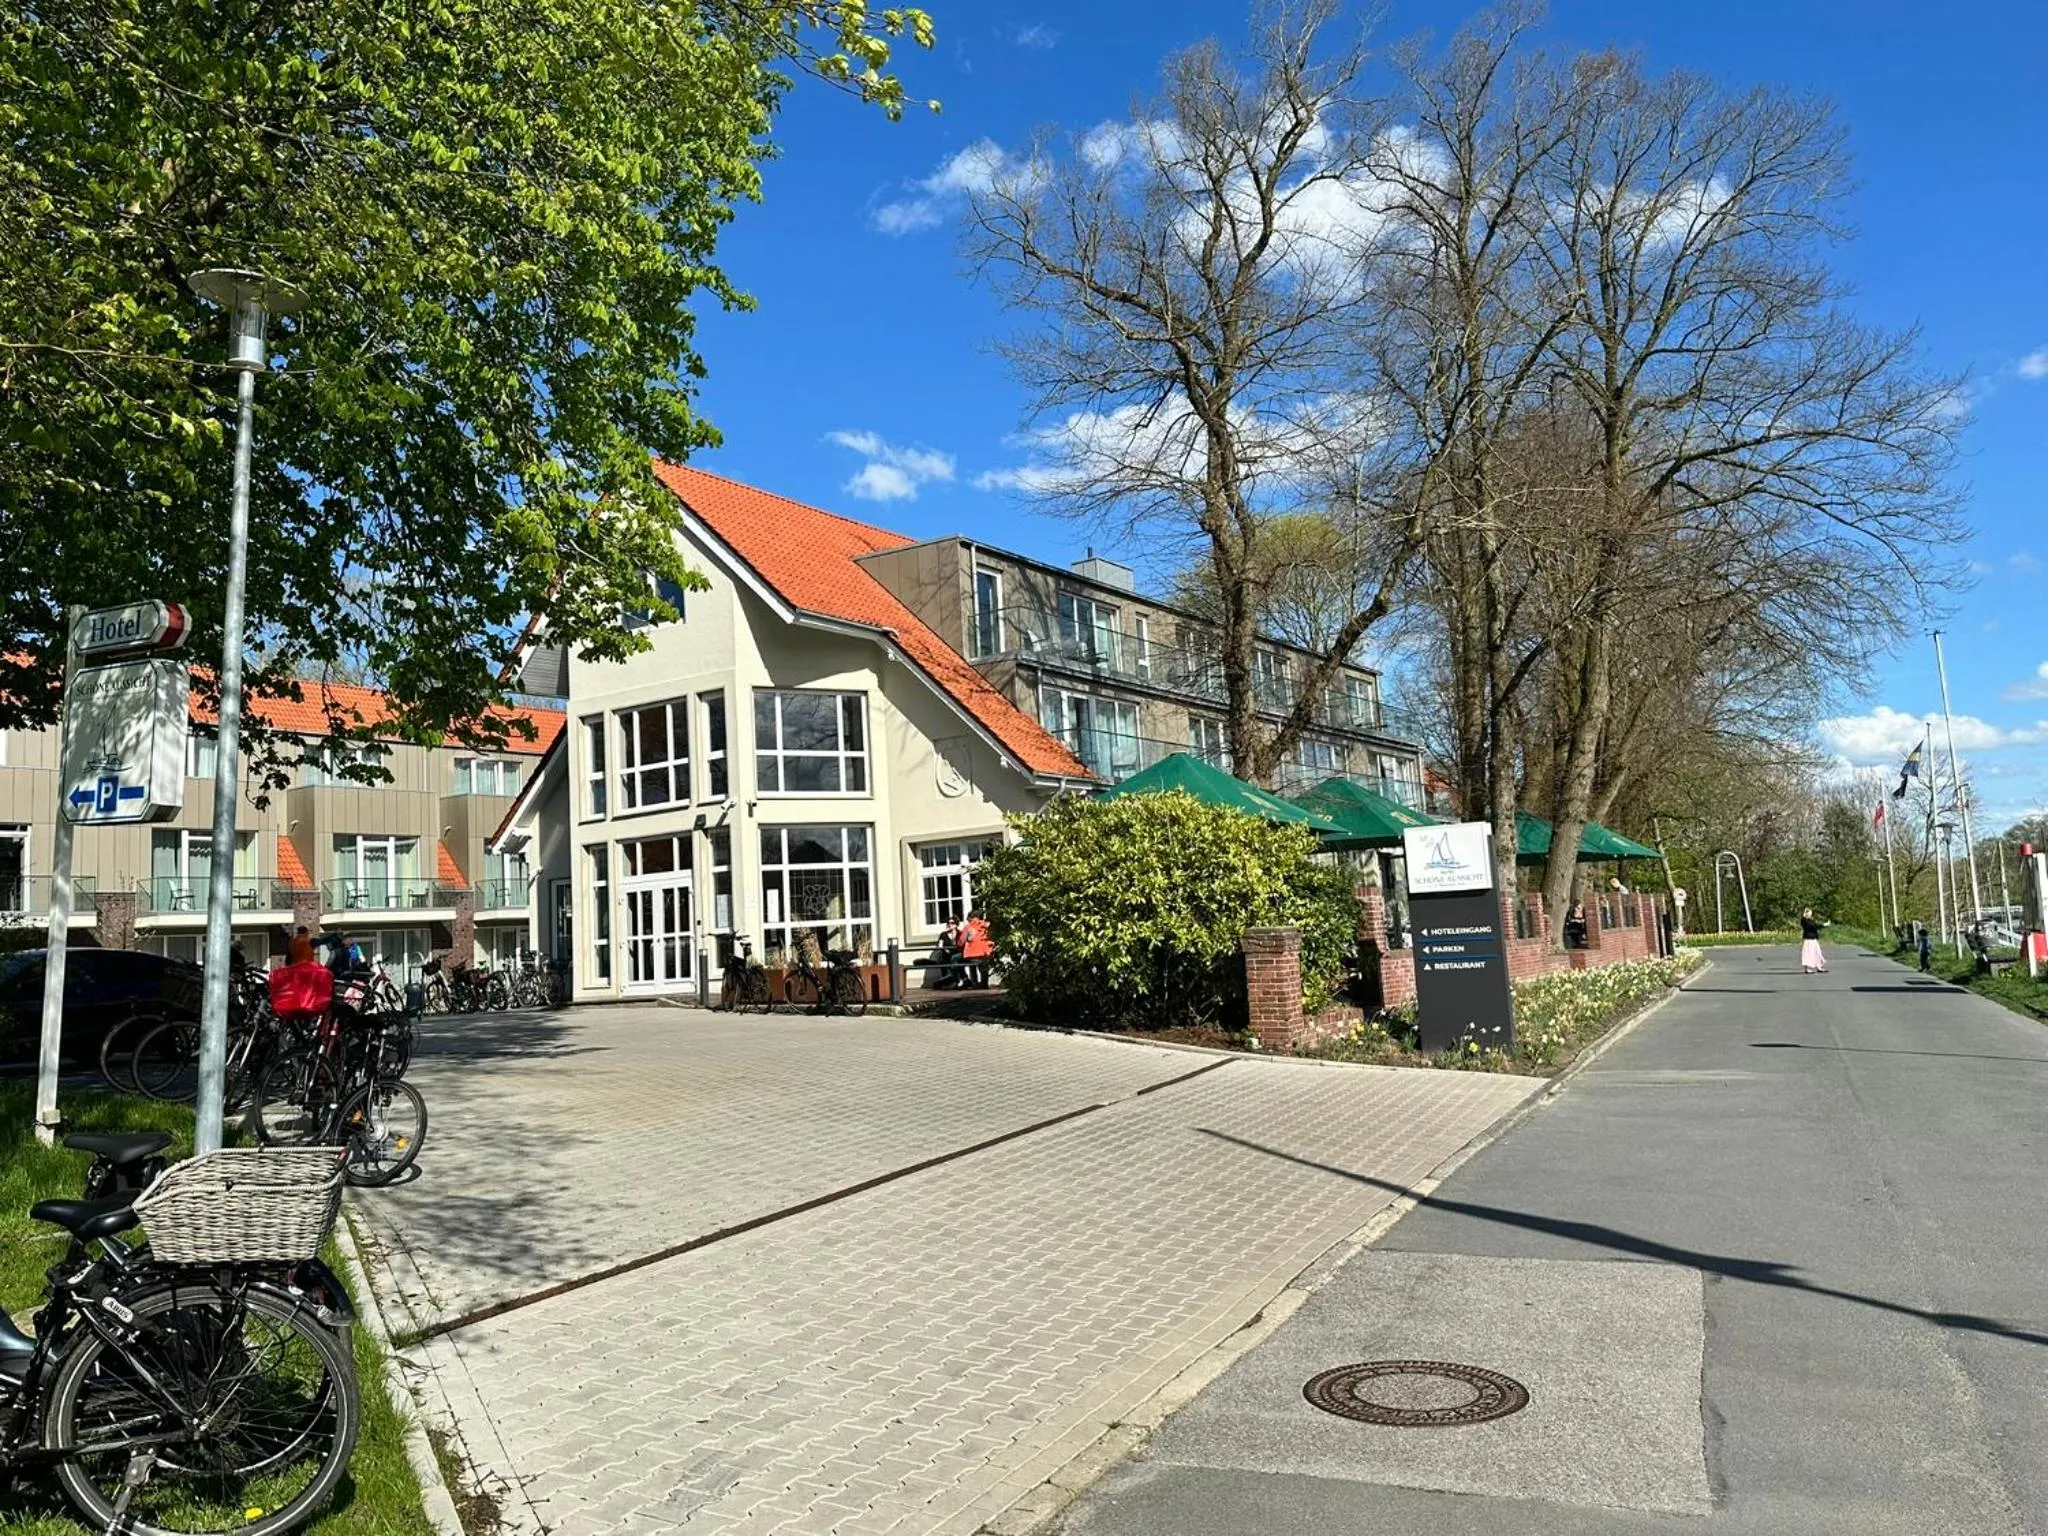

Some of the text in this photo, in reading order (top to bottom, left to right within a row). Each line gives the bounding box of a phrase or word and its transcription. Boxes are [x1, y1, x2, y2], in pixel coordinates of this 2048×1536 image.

[91, 610, 140, 642] Hotel
[100, 782, 113, 809] P
[1431, 926, 1492, 935] HOTELEINGANG
[1432, 945, 1465, 953] PARKEN
[1434, 961, 1486, 970] RESTAURANT
